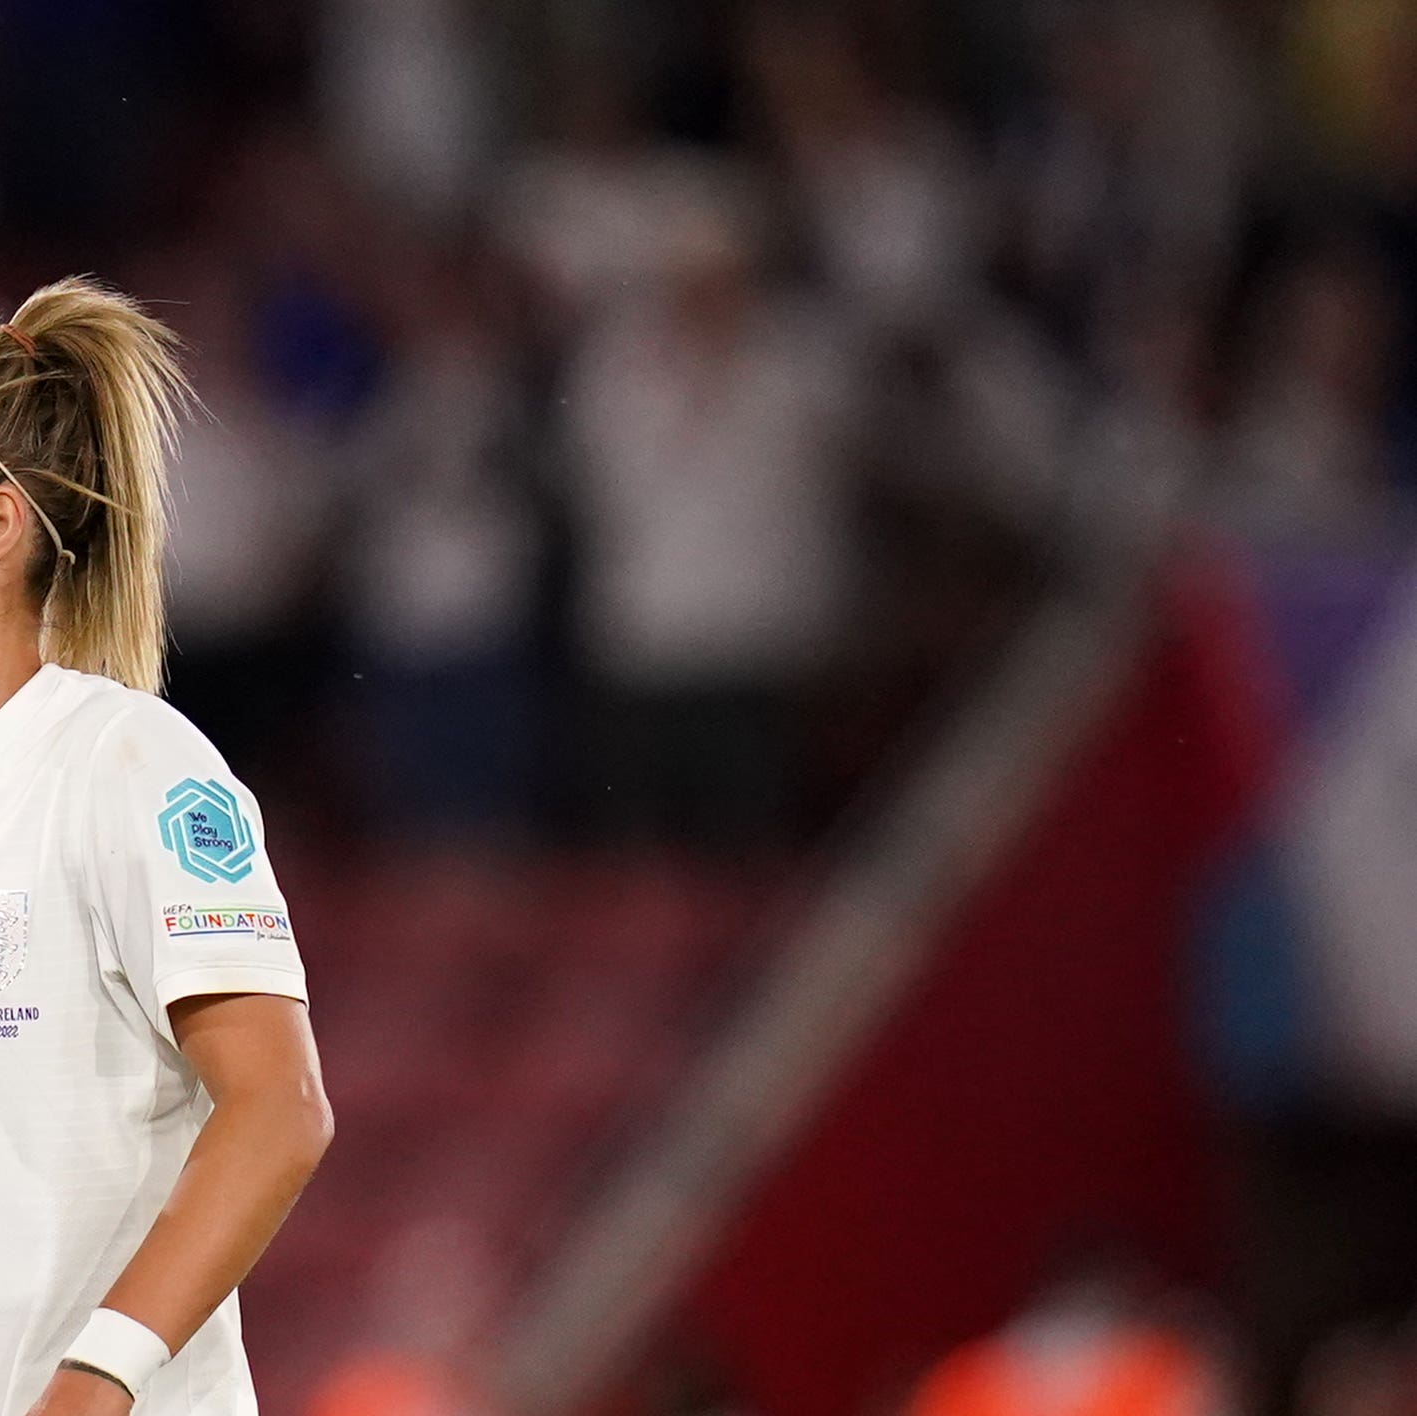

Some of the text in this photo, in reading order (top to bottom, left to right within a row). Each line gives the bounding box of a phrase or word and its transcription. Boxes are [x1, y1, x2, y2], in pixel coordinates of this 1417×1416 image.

[188, 812, 207, 823] We
[192, 824, 217, 838] Play
[194, 837, 233, 852] Strong
[163, 904, 192, 916] UEFA
[165, 913, 288, 932] FOUNDATION
